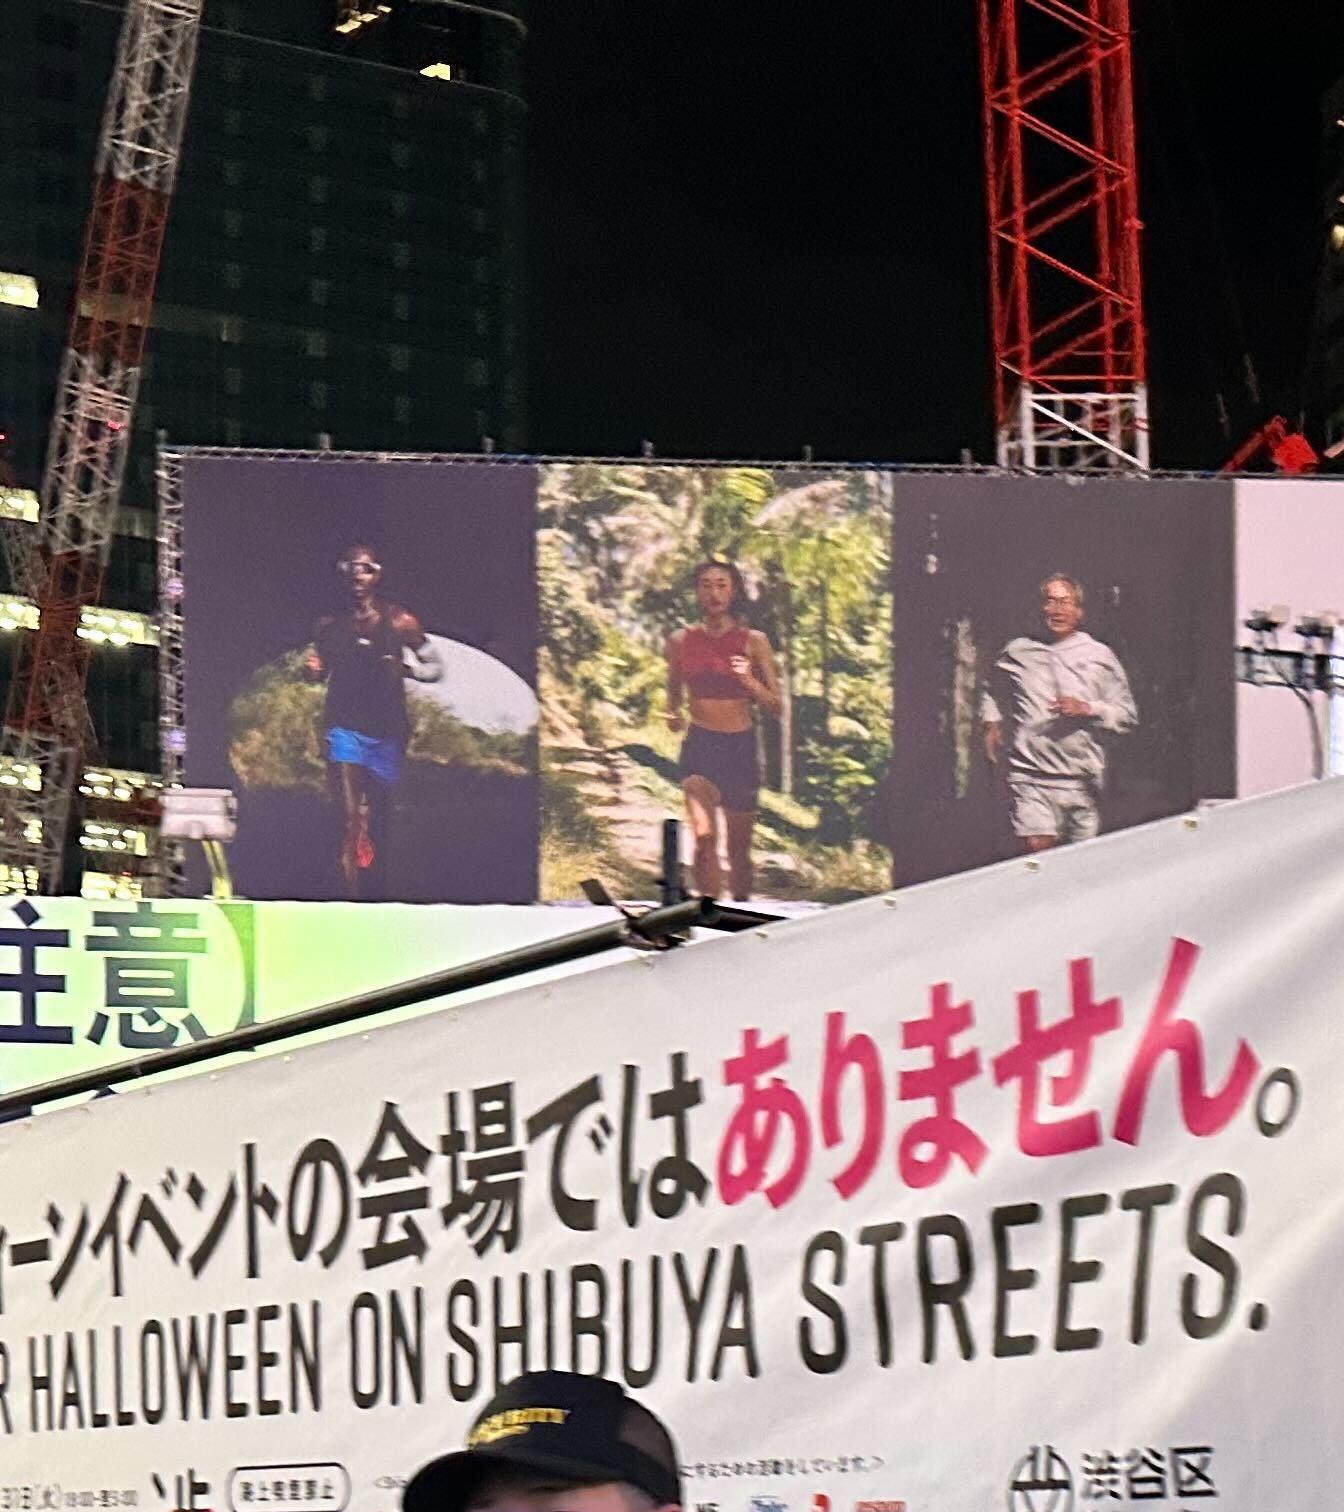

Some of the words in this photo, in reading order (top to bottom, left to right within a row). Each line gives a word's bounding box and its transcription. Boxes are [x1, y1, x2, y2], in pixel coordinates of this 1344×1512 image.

[29, 1300, 320, 1432] HALLOWEEN
[350, 1287, 425, 1409] ON
[447, 1244, 758, 1402] SHIBUYA
[799, 1173, 1268, 1375] STREETS.
[1080, 1445, 1219, 1501] 渋谷区
